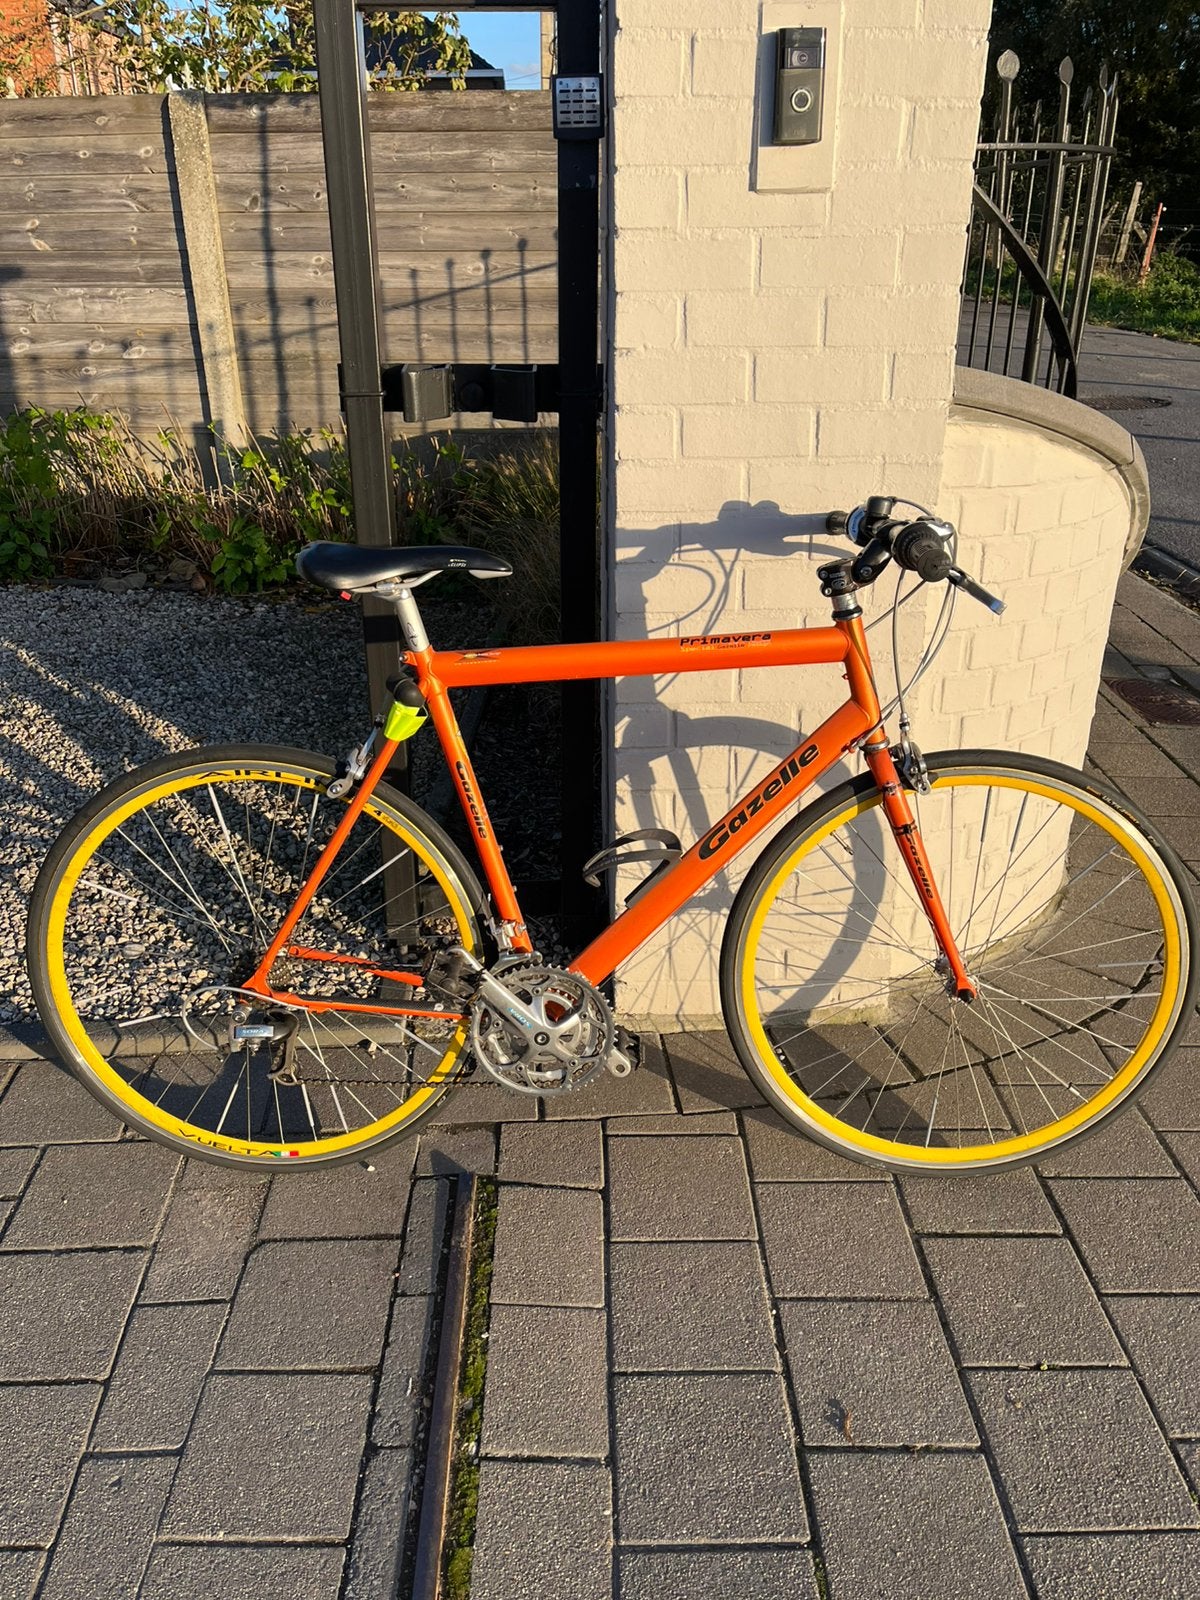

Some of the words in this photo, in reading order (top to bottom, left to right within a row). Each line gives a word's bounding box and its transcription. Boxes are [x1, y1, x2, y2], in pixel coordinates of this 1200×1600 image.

[680, 633, 772, 646] Primavera
[455, 760, 488, 839] Gazelle
[698, 744, 820, 860] Gazelle
[178, 1128, 278, 1156] VUELTA
